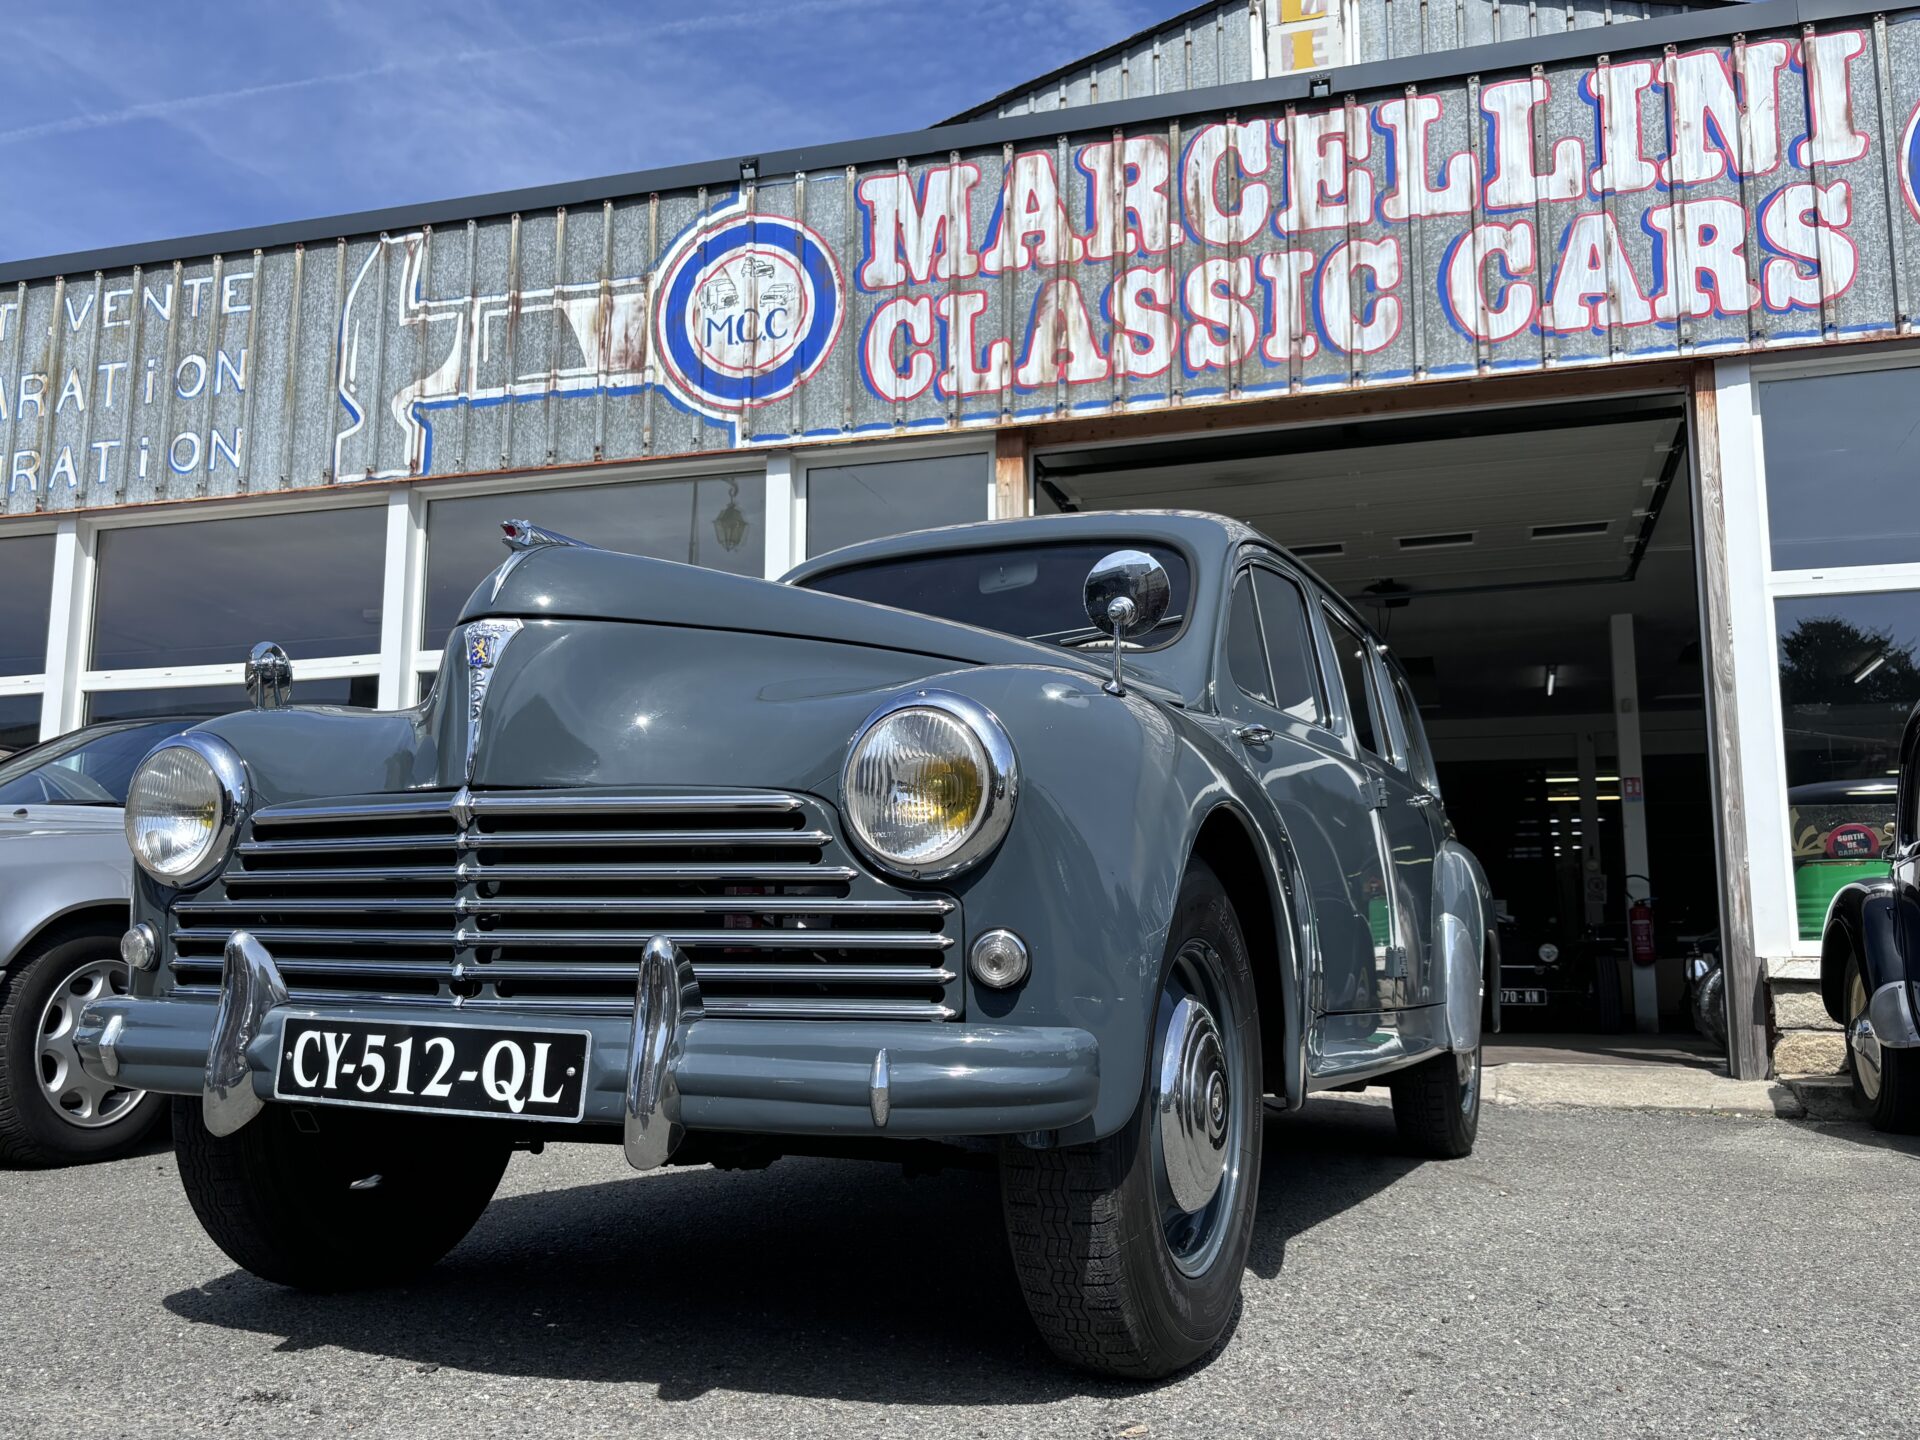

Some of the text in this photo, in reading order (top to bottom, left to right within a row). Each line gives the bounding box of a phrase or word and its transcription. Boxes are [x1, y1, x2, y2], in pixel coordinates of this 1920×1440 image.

[855, 29, 1870, 291] MARCELLINI
[859, 178, 1859, 403] CLASSIC CARS
[0, 347, 248, 421] RATiON
[0, 428, 243, 493] RATiON
[1836, 832, 1865, 842] SORTIE
[1837, 847, 1869, 857] GARAGE
[1847, 841, 1858, 849] DE
[292, 1030, 564, 1113] CY-512-QL
